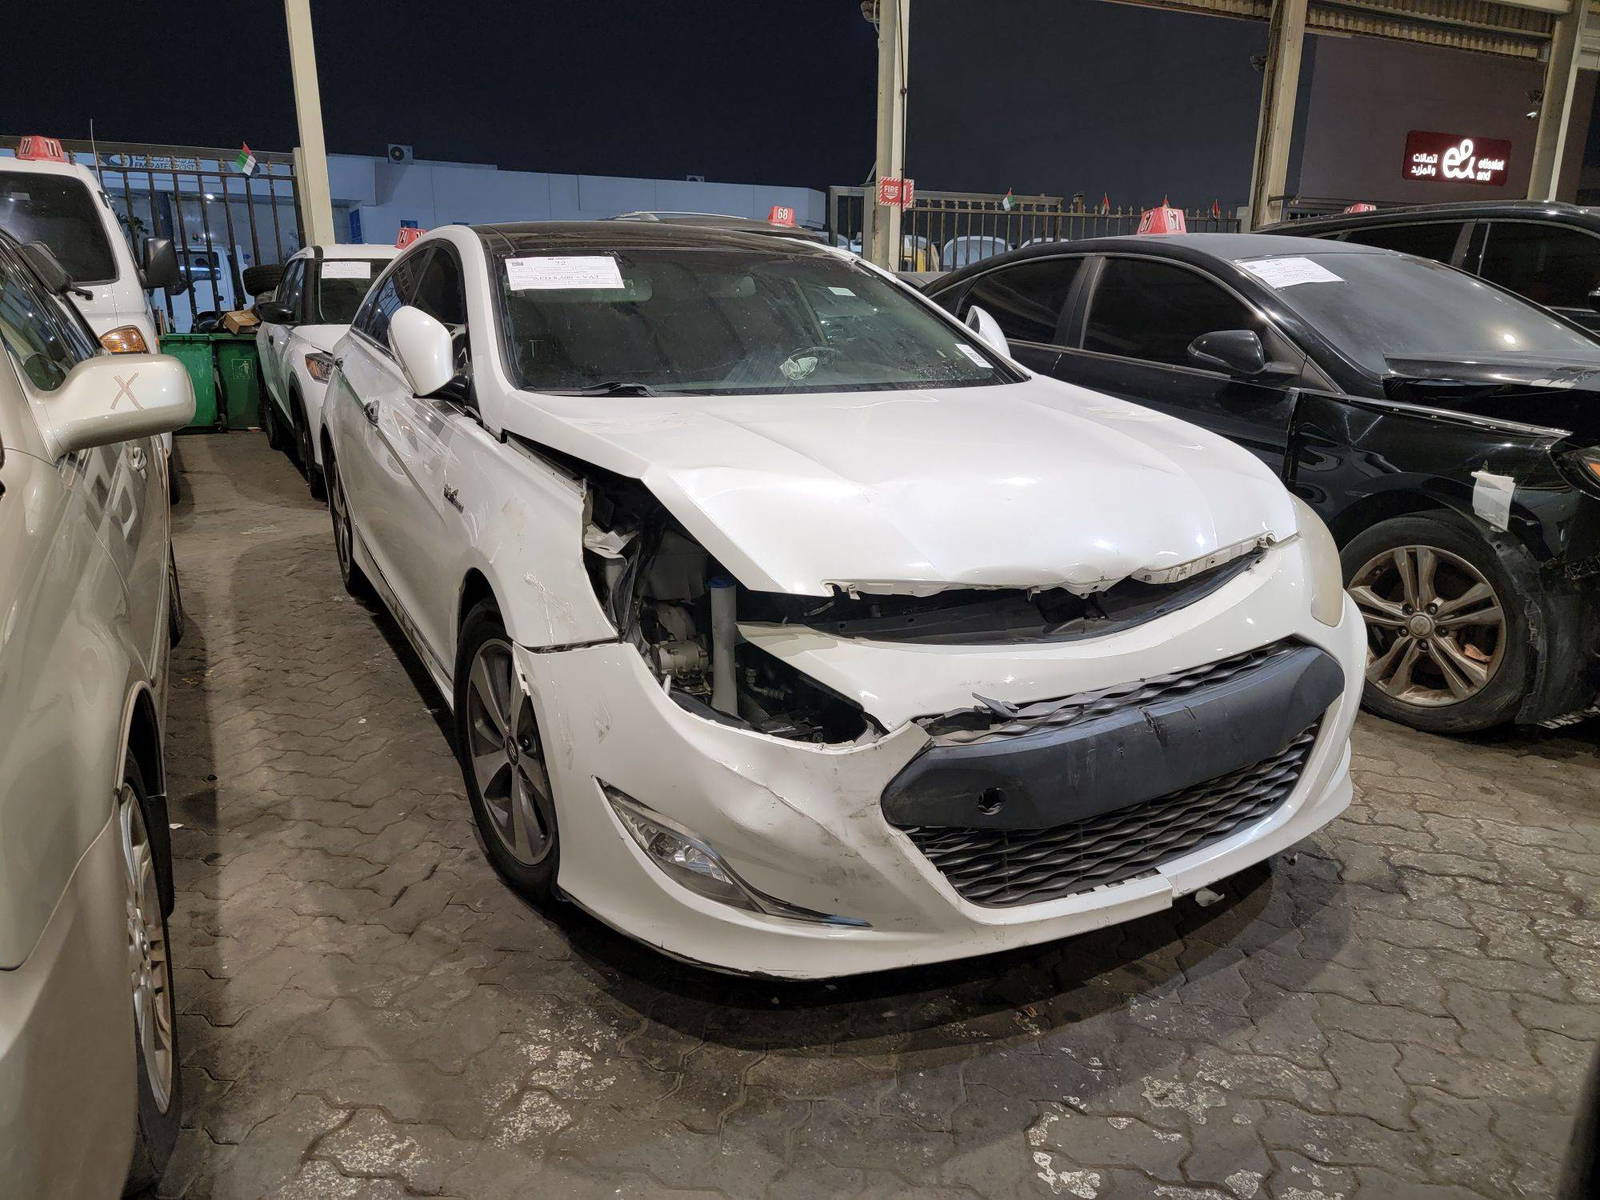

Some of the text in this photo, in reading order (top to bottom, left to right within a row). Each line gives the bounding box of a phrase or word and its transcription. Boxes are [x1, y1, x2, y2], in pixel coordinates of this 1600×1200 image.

[1478, 158, 1504, 170] etisalat
[1477, 171, 1491, 181] and
[884, 185, 899, 193] FIRE
[777, 207, 789, 220] 68
[1167, 209, 1180, 231] 67
